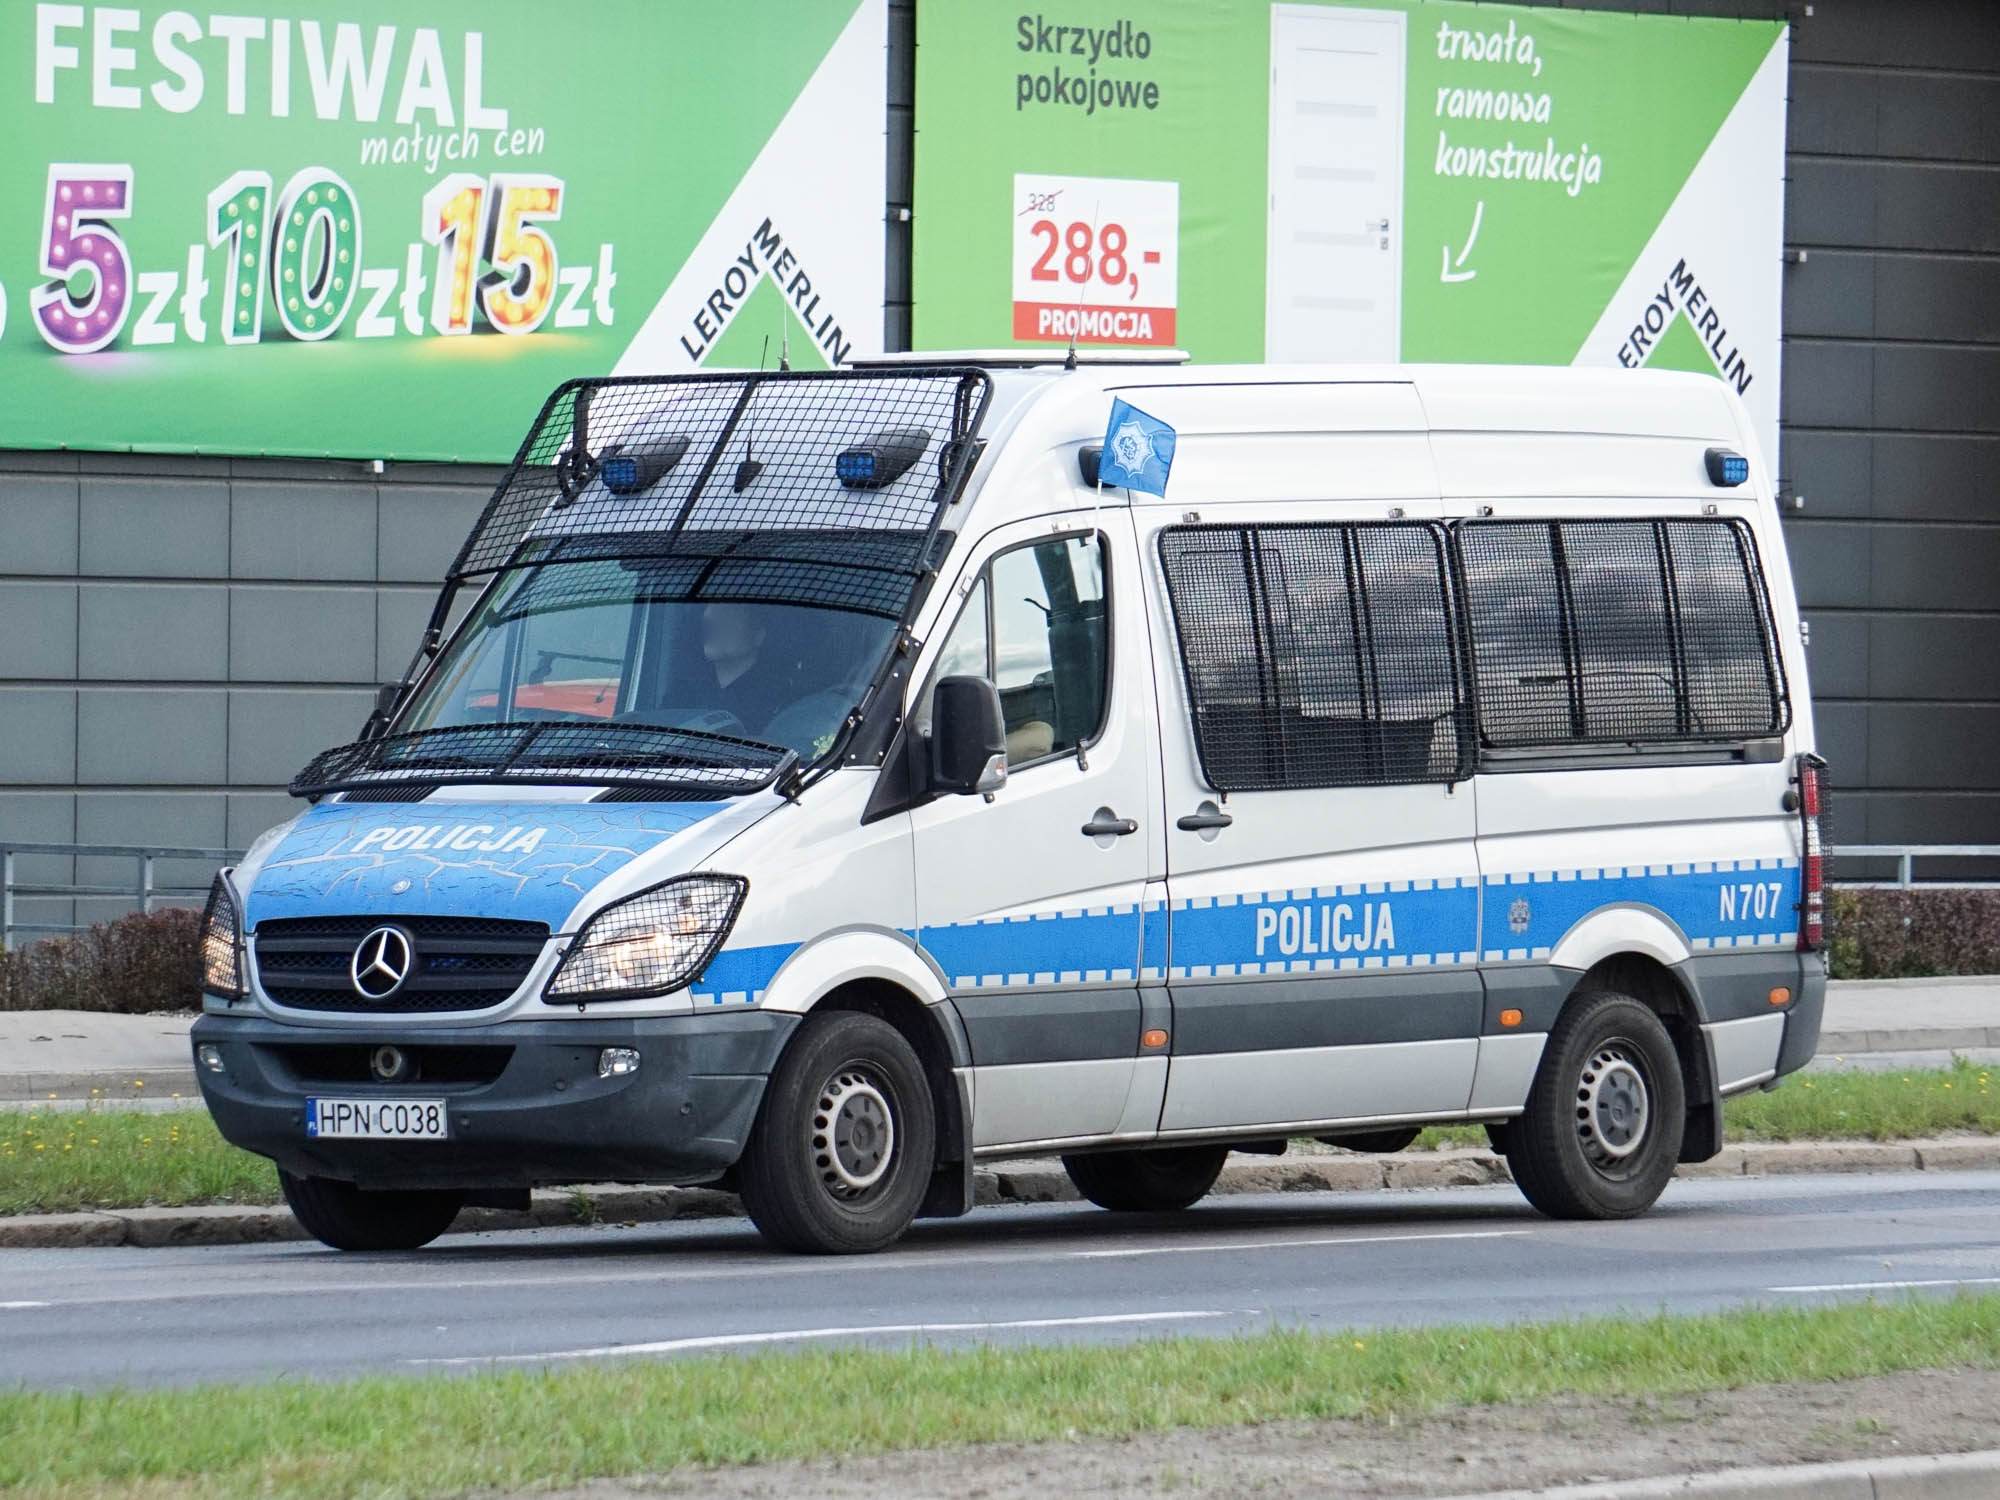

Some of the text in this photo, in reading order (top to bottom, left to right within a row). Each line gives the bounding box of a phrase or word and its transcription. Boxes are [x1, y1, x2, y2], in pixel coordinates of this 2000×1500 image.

[1017, 14, 1152, 65] Skrzydło
[1436, 19, 1543, 77] trwała,
[35, 3, 508, 130] FESTIWAL
[1016, 66, 1159, 116] pokojowe
[1435, 87, 1552, 124] ramowa
[360, 121, 545, 174] małych cen
[1434, 130, 1603, 197] konstrukcja
[1028, 193, 1055, 212] 328
[1030, 220, 1160, 301] 288,-
[680, 217, 852, 367] LEROY MERLIN
[1039, 308, 1152, 339] PROMOCJA
[1617, 258, 1753, 397] EROY MERLIN
[350, 825, 549, 854] POLICJA
[1720, 882, 1782, 921] N707
[1256, 902, 1395, 956] POLICJA
[320, 1103, 370, 1133] HPN
